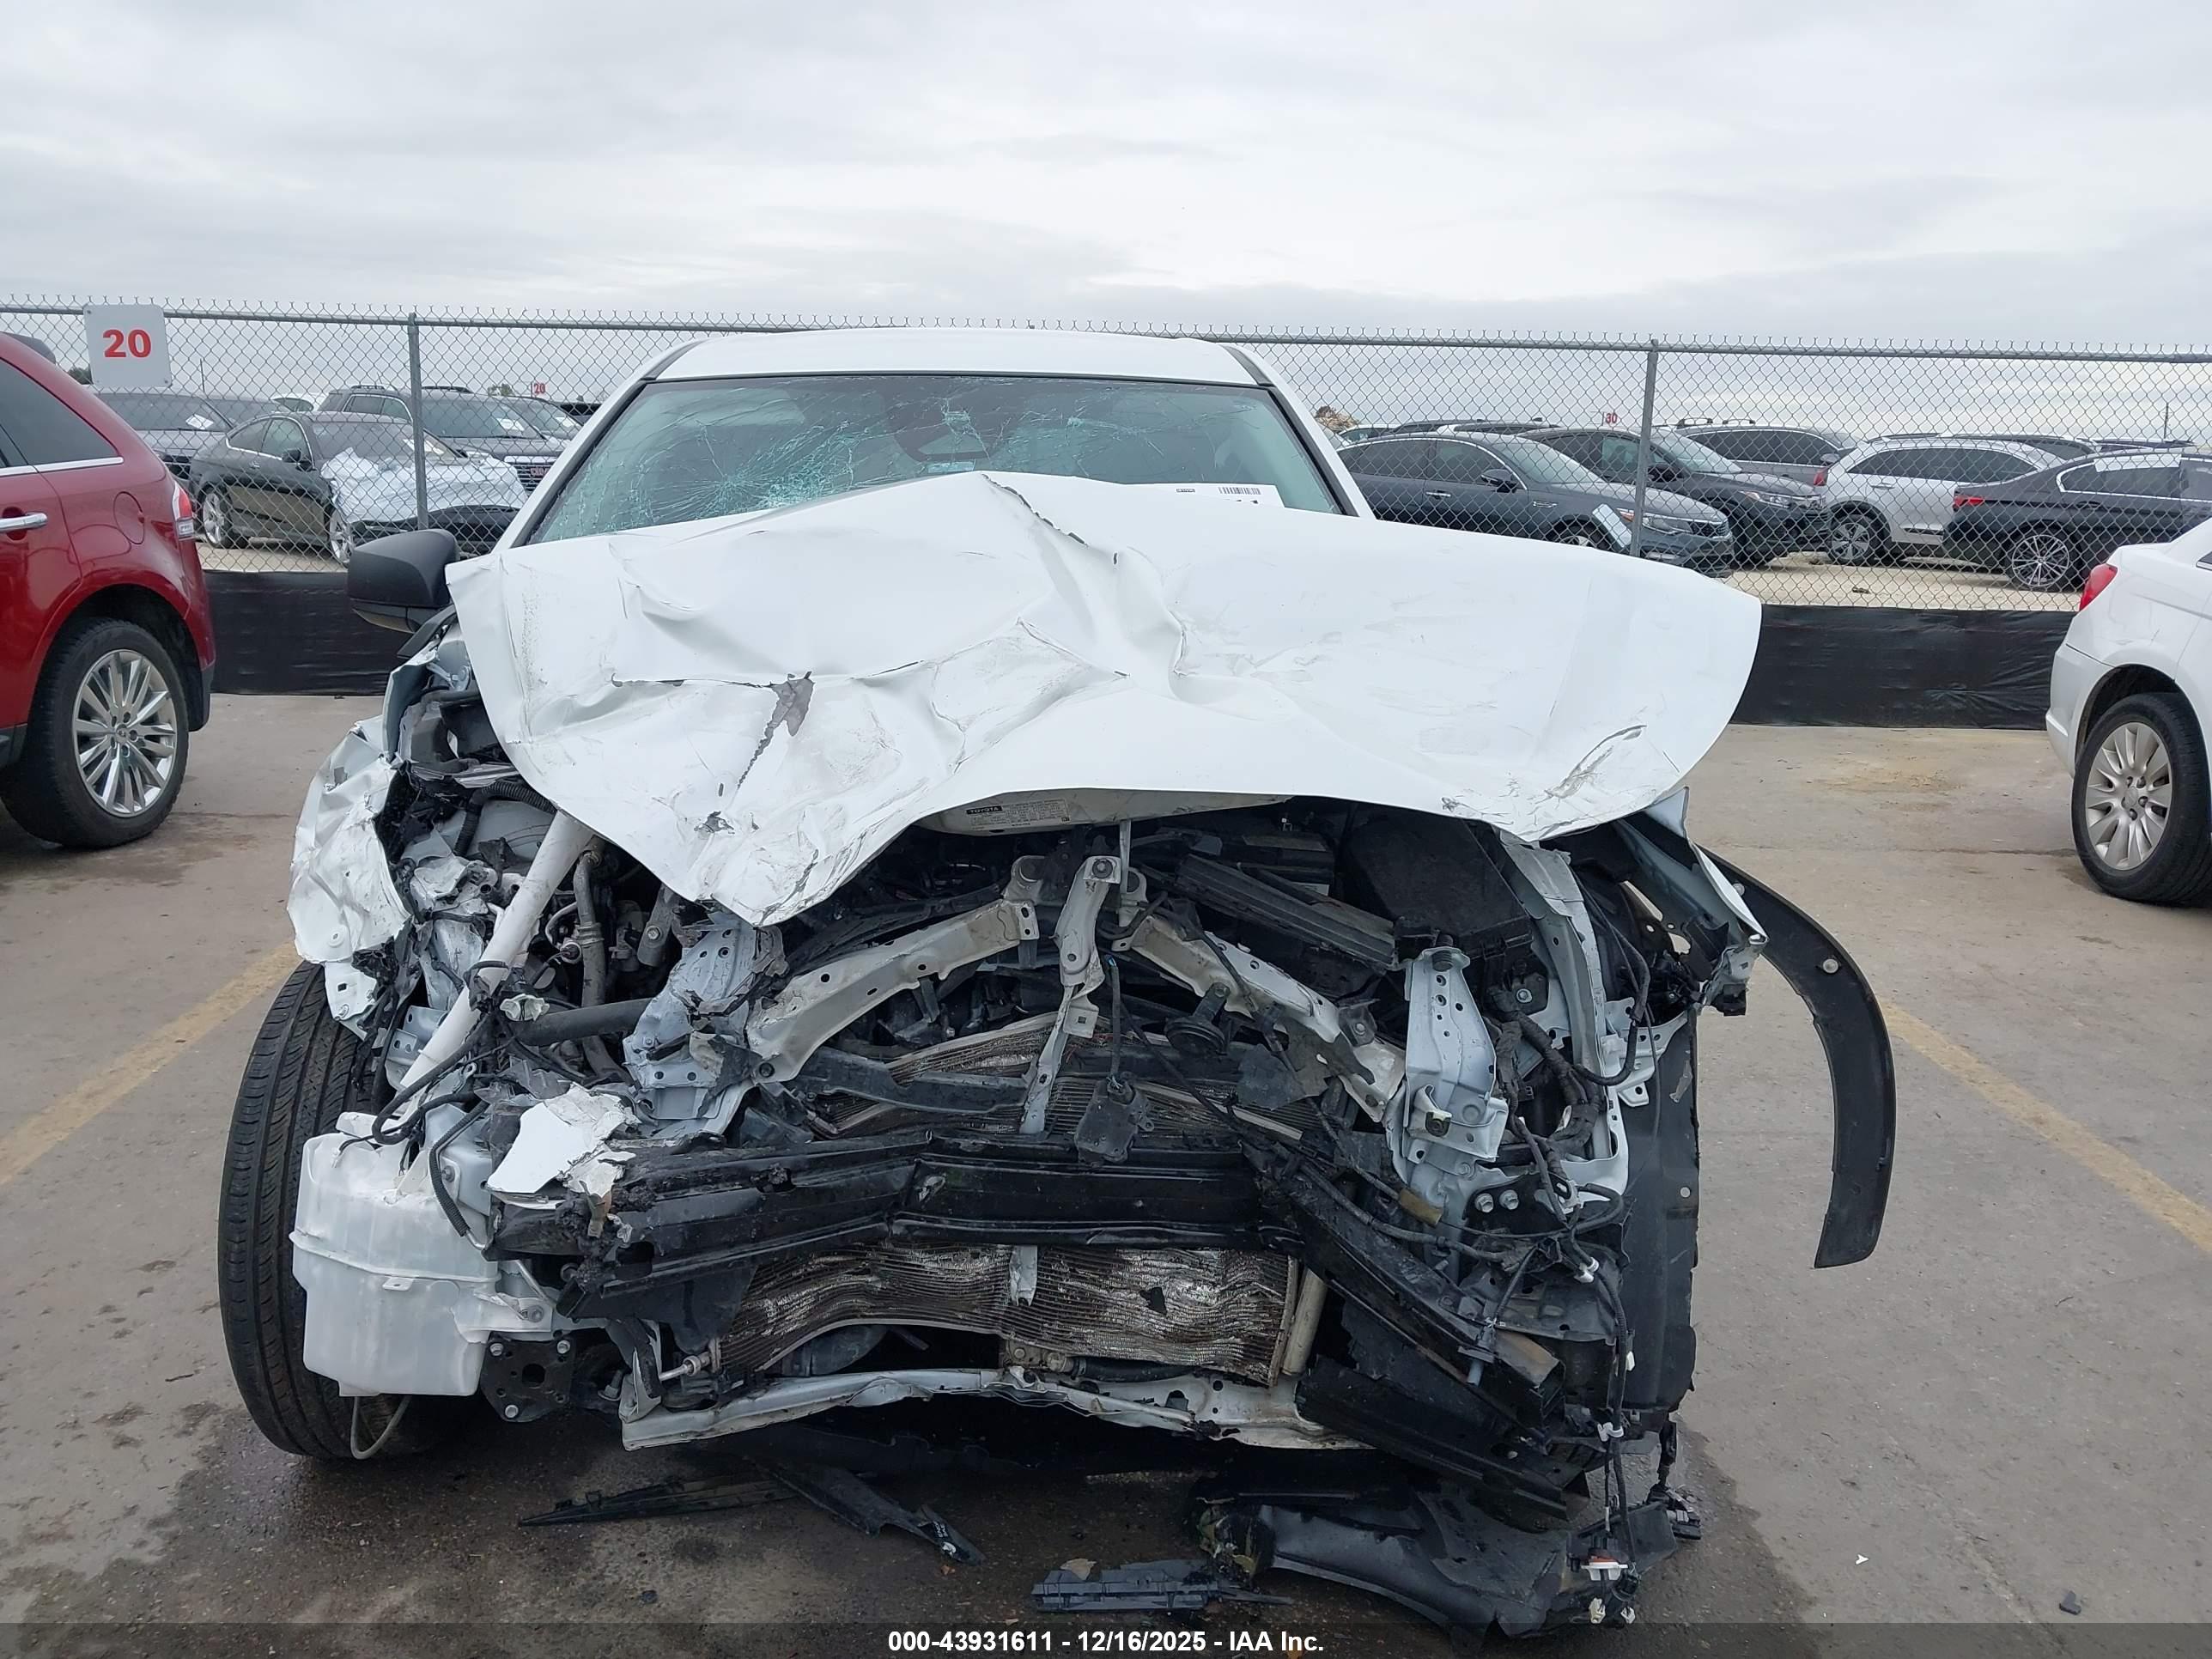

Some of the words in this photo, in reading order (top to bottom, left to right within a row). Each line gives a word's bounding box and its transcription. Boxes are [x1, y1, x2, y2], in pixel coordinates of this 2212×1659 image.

[102, 329, 152, 358] 20
[533, 382, 546, 394] 20
[1606, 412, 1618, 424] 30
